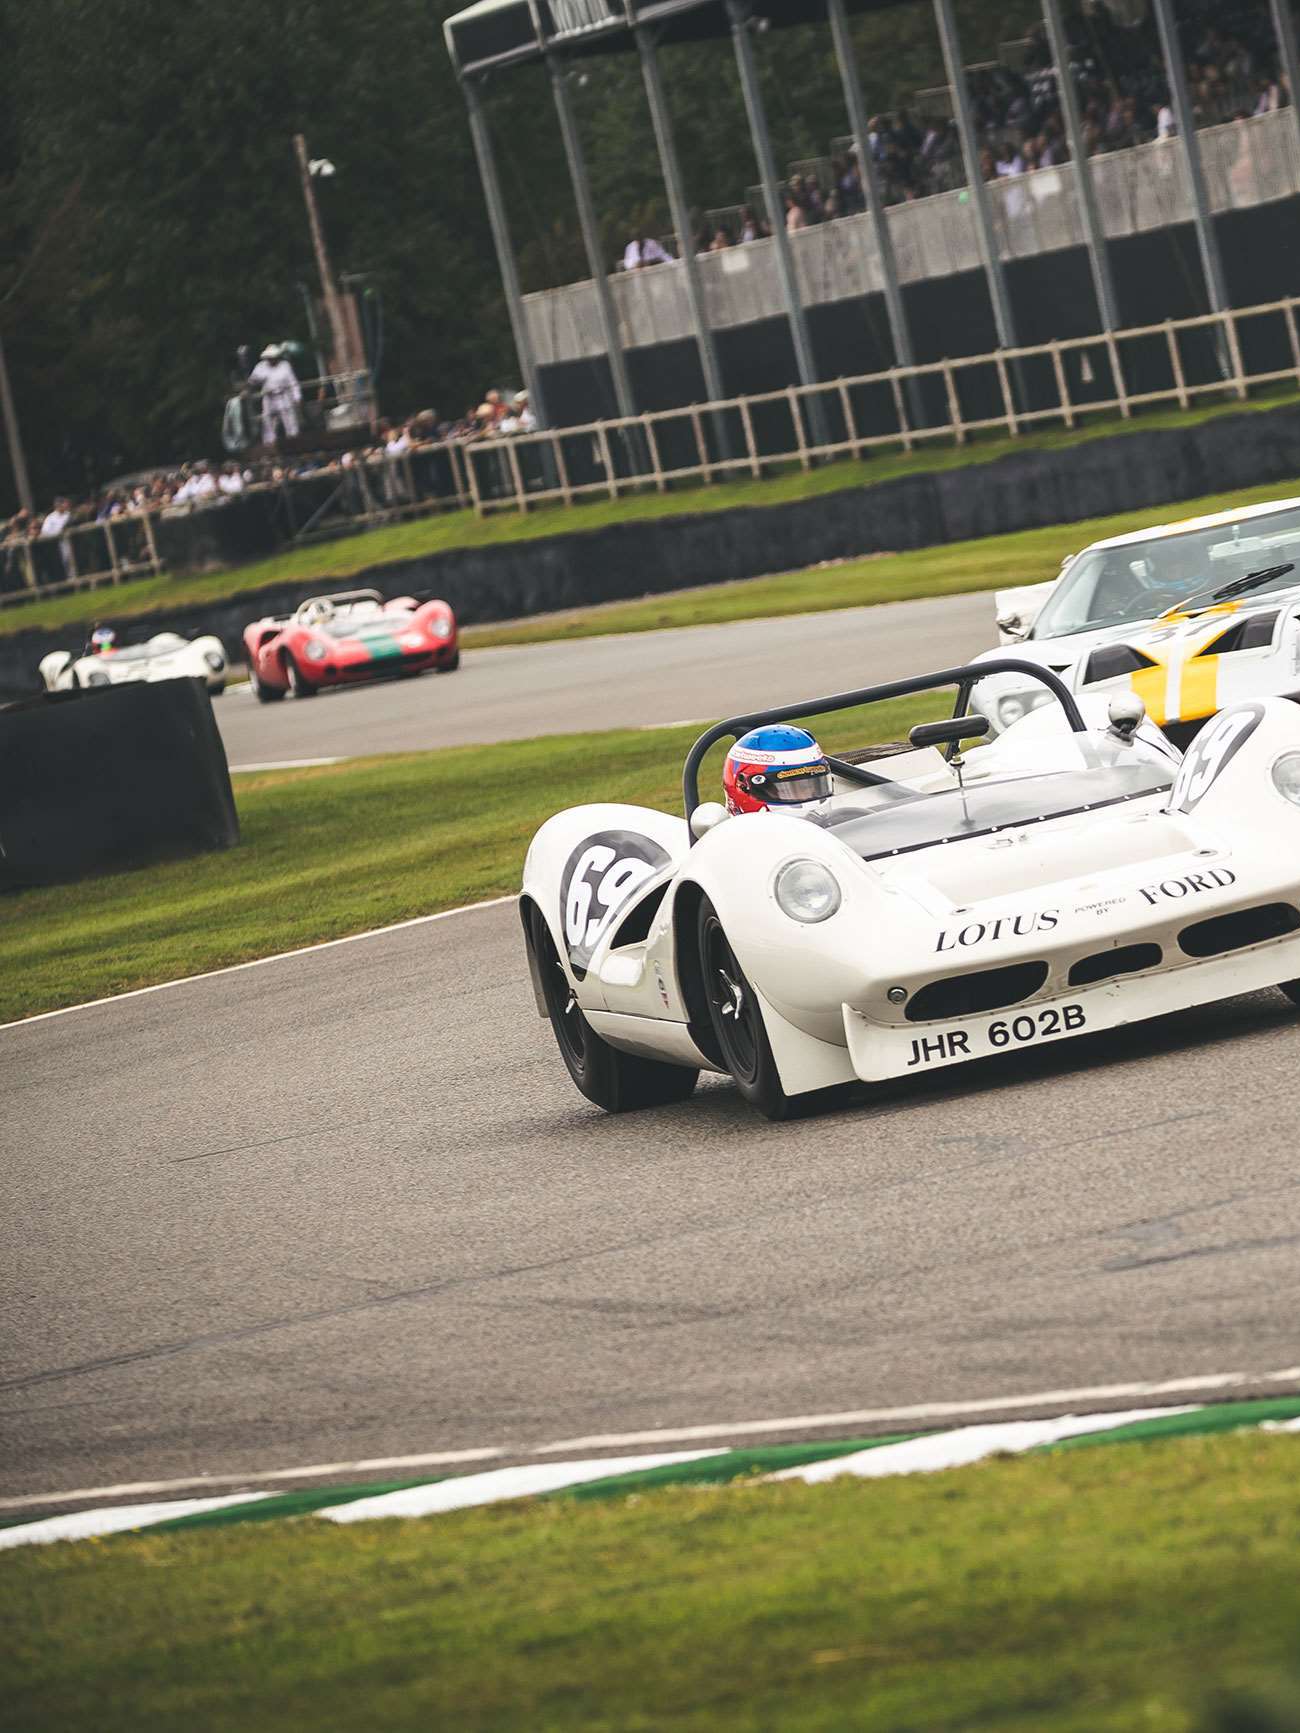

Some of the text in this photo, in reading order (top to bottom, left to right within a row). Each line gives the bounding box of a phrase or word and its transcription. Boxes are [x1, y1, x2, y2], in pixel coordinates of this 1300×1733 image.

[565, 845, 657, 948] 69
[936, 868, 1236, 952] LOTUS FORD
[907, 1004, 1086, 1066] JHR 602B
